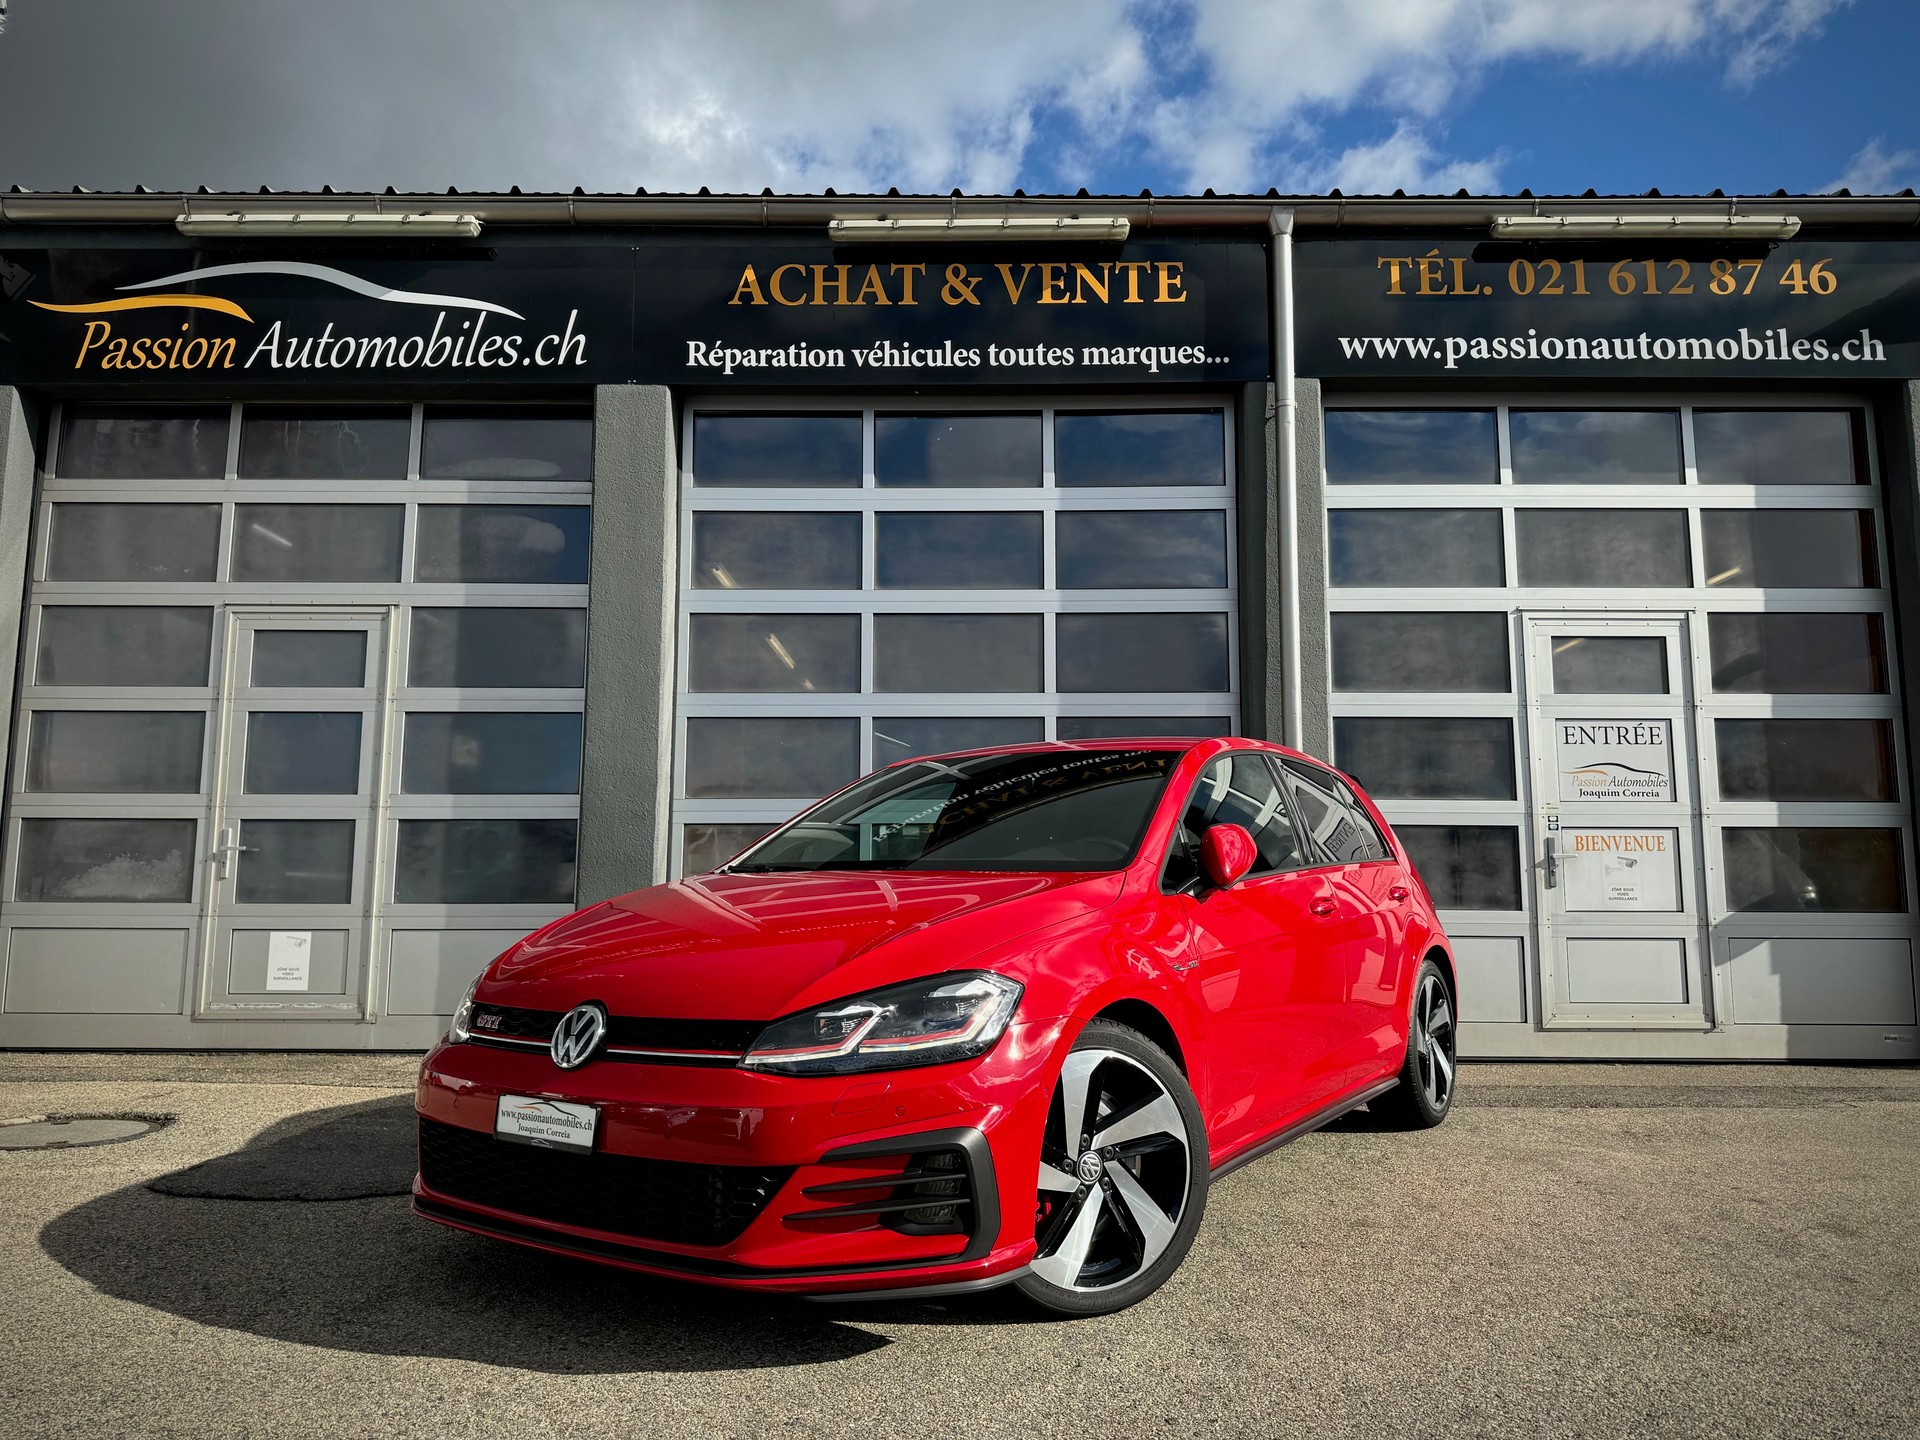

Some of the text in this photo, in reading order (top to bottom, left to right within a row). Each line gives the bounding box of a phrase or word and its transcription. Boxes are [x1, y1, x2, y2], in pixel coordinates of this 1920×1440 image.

[728, 261, 1188, 306] ACHAT & VENTE
[1377, 248, 1838, 296] TÉL. 021 612 87 46
[75, 309, 588, 370] Passion Automobiles.ch
[1338, 327, 1887, 369] www.passionautomobiles.ch
[686, 339, 1230, 375] Réparation véhicules toutes marques...
[1562, 722, 1663, 746] ENTRÉE
[1571, 774, 1669, 788] Passion Automobiles
[1579, 788, 1660, 798] Joaquim Correia
[1574, 835, 1666, 852] BIENVENUE
[476, 1013, 502, 1029] GTI
[501, 1108, 593, 1132] www.passionautomobiles.ch
[518, 1123, 571, 1139] Joaquim Correia
